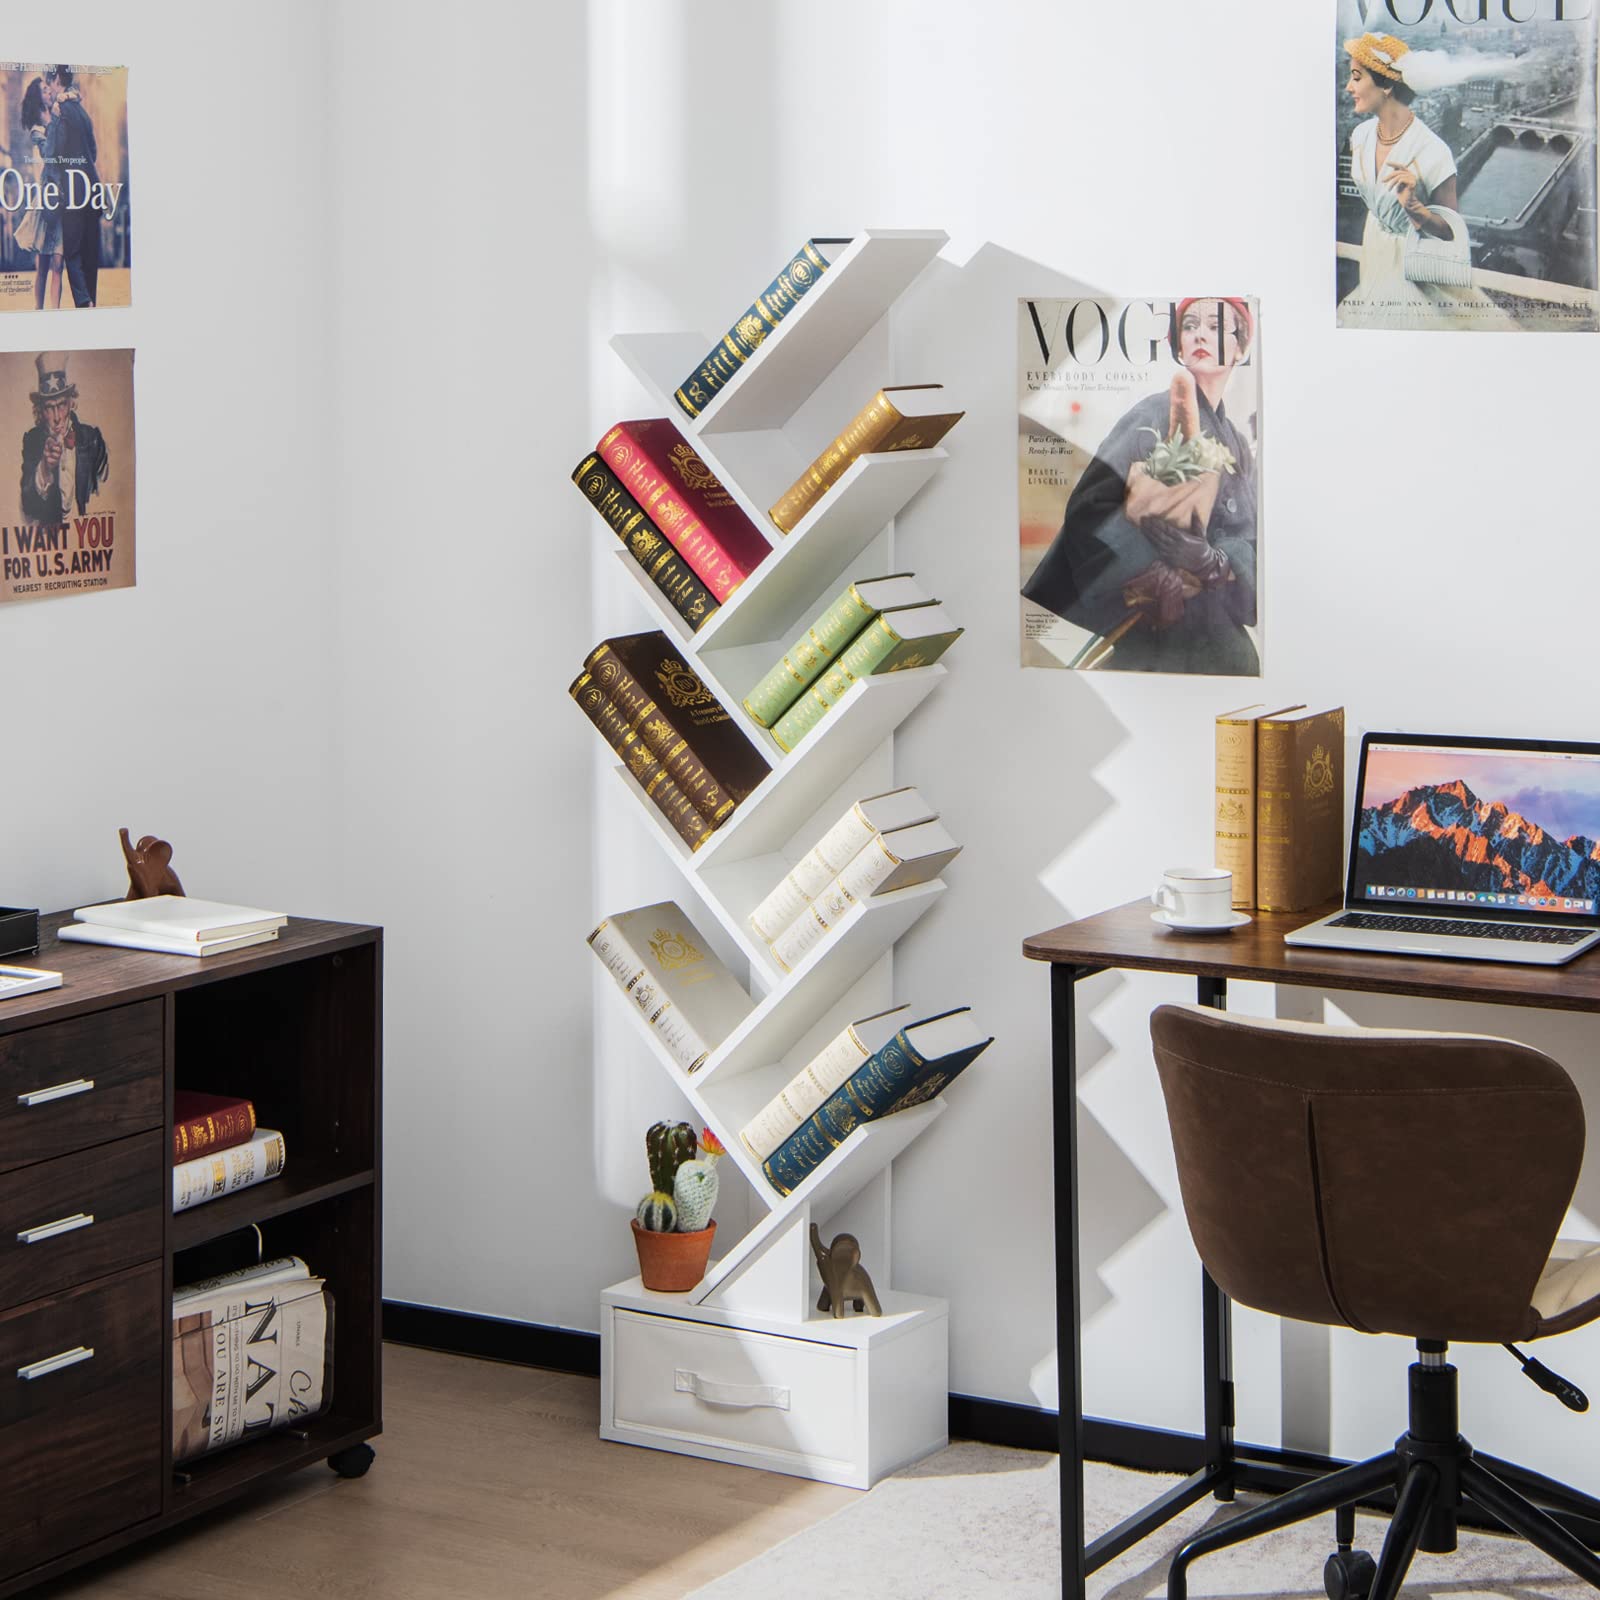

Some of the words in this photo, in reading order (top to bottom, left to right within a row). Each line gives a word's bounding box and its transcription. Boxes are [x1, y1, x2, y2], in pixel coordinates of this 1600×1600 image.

[0, 168, 59, 212] One
[65, 169, 124, 220] Day
[1022, 299, 1251, 368] VOGUE
[2, 527, 9, 555] I
[14, 522, 70, 554] WANT
[74, 516, 114, 549] YOU
[4, 556, 31, 581] FOR
[12, 583, 42, 594] NEAREST
[45, 579, 82, 591] RECRUITING
[83, 578, 108, 588] STATION
[215, 1317, 226, 1360] YOU
[215, 1369, 227, 1408] ARE
